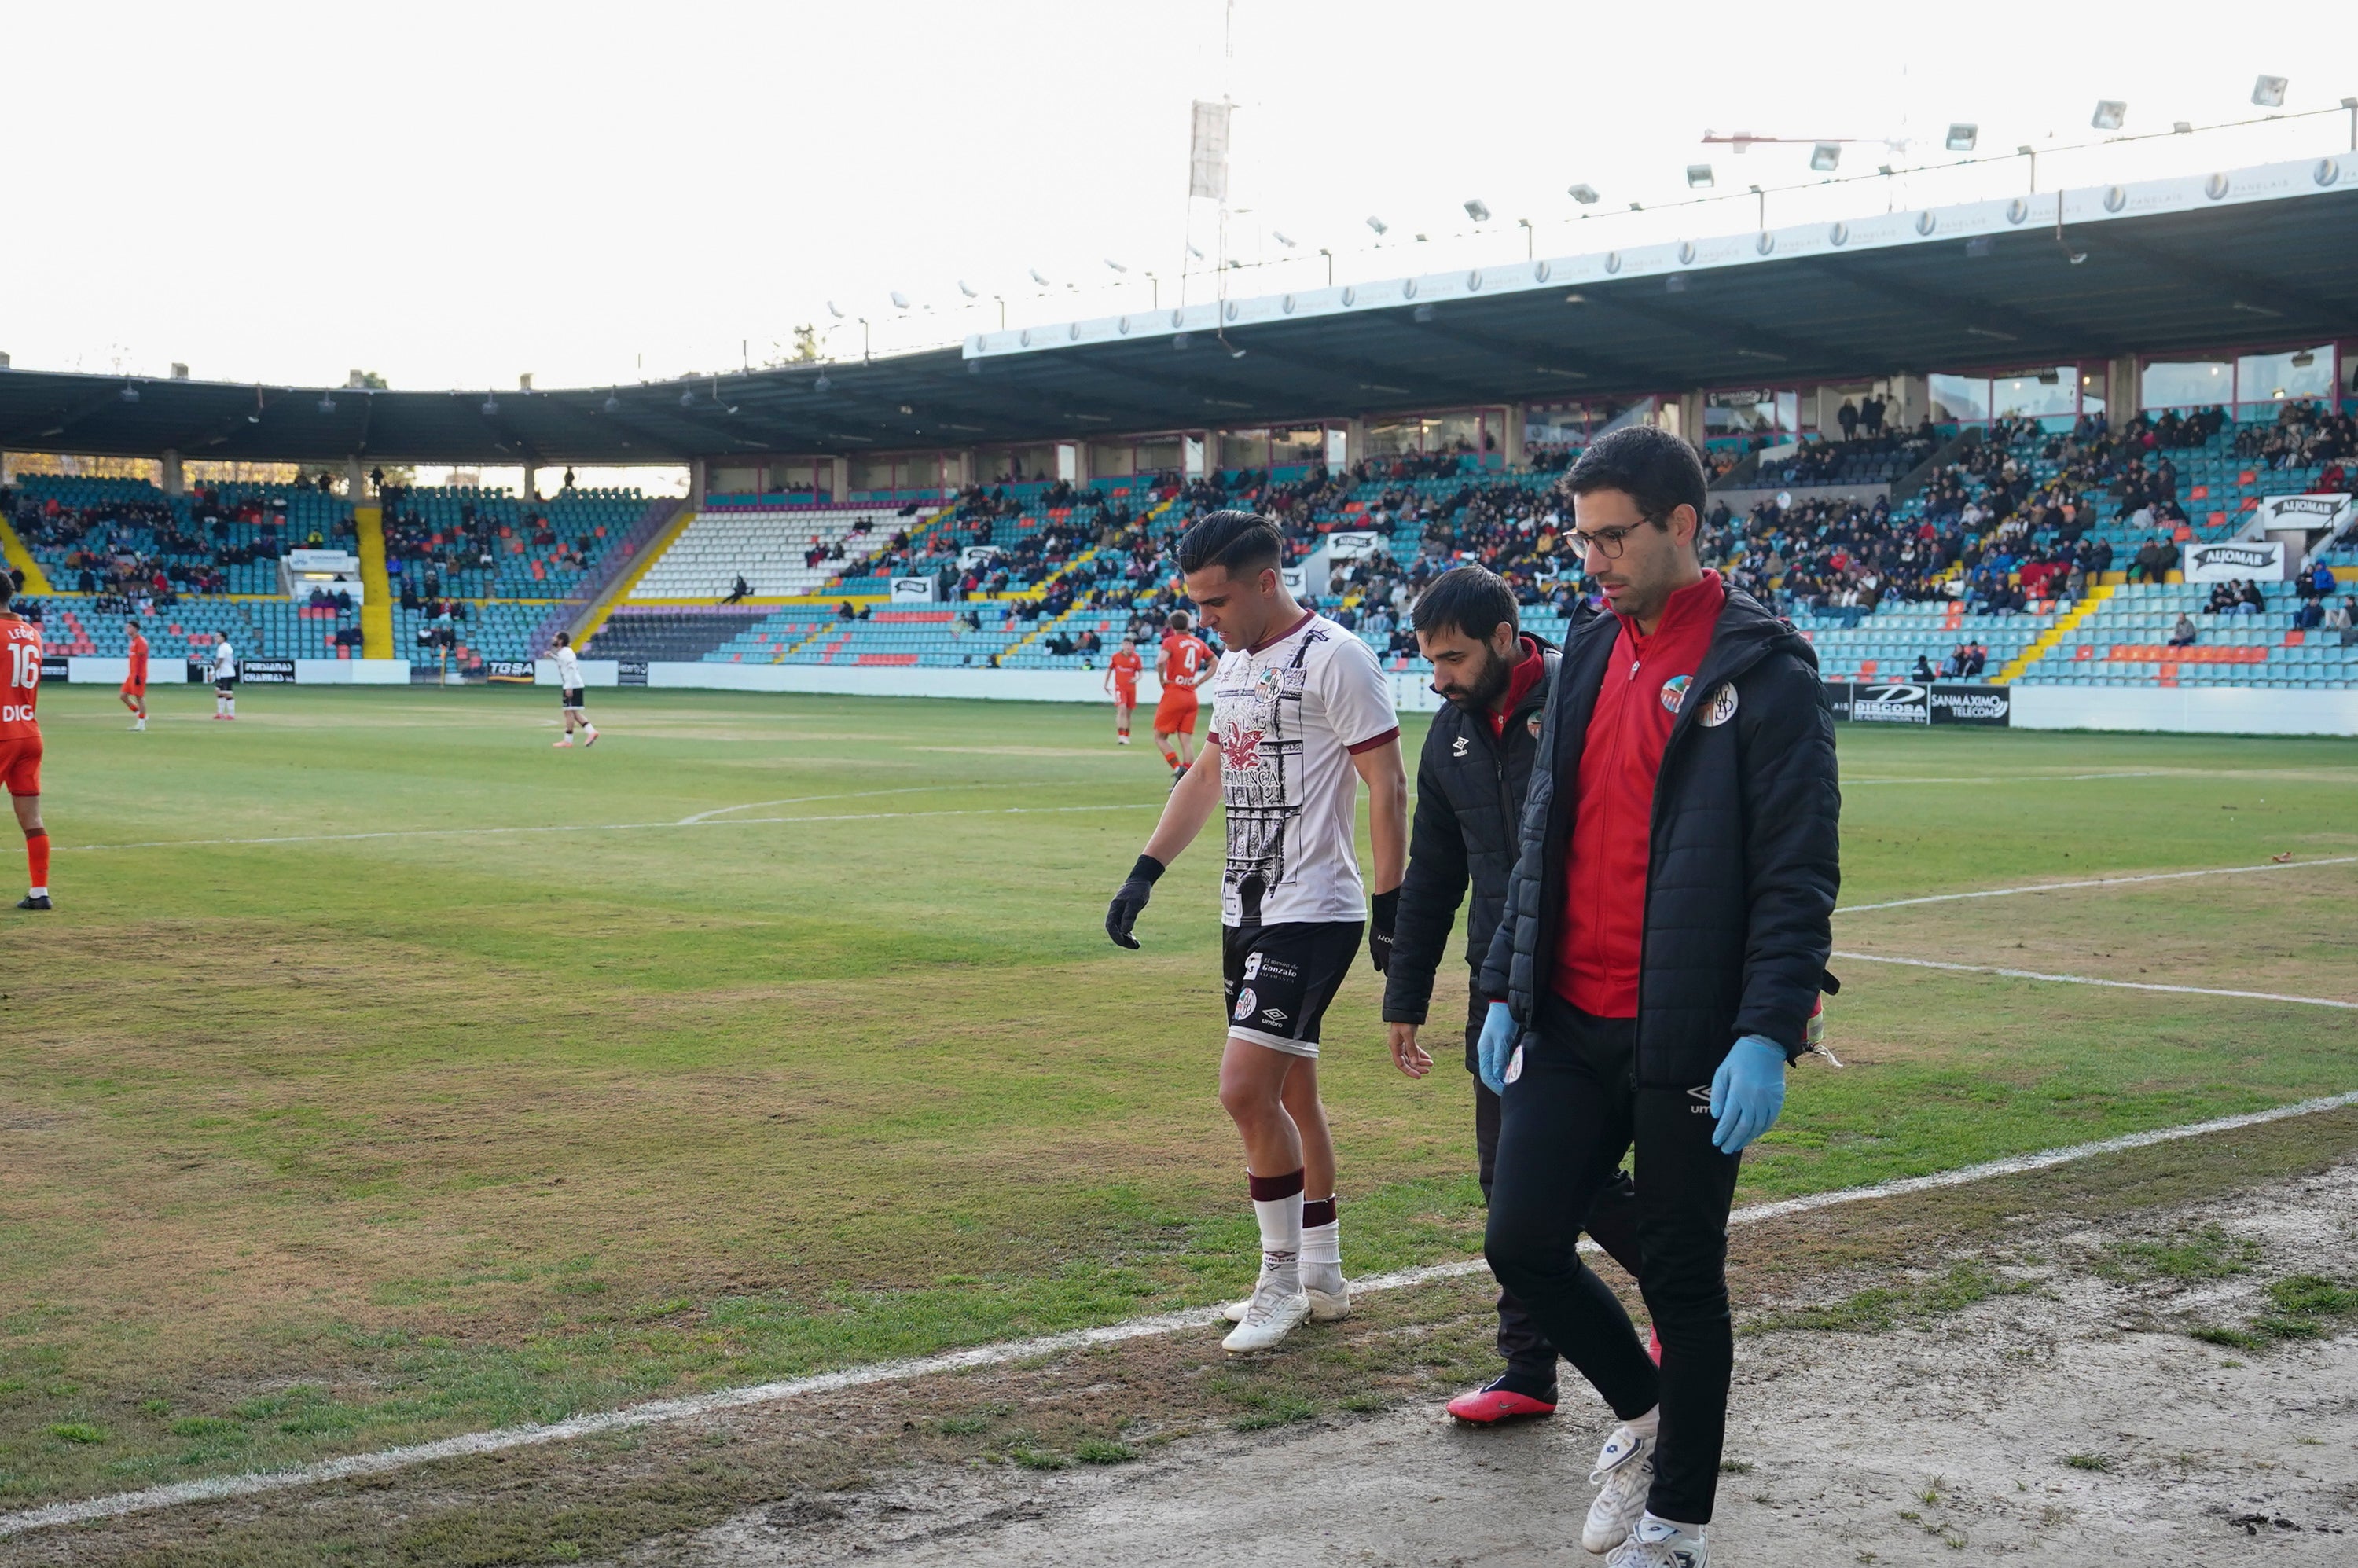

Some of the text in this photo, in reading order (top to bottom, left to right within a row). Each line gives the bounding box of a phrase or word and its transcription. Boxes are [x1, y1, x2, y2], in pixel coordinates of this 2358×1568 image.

[2282, 500, 2331, 514] ALJOMAR
[2206, 550, 2263, 566] ALJOMAR
[7, 642, 40, 689] 16
[1184, 647, 1196, 673] 4
[489, 662, 534, 674] TGSA
[1931, 692, 2000, 707] SANMÁXIMO
[1855, 703, 1926, 713] DISCOSA
[1952, 706, 1994, 718] TELECOM
[1262, 963, 1297, 978] Gonzalo
[1262, 1018, 1283, 1028] umbro
